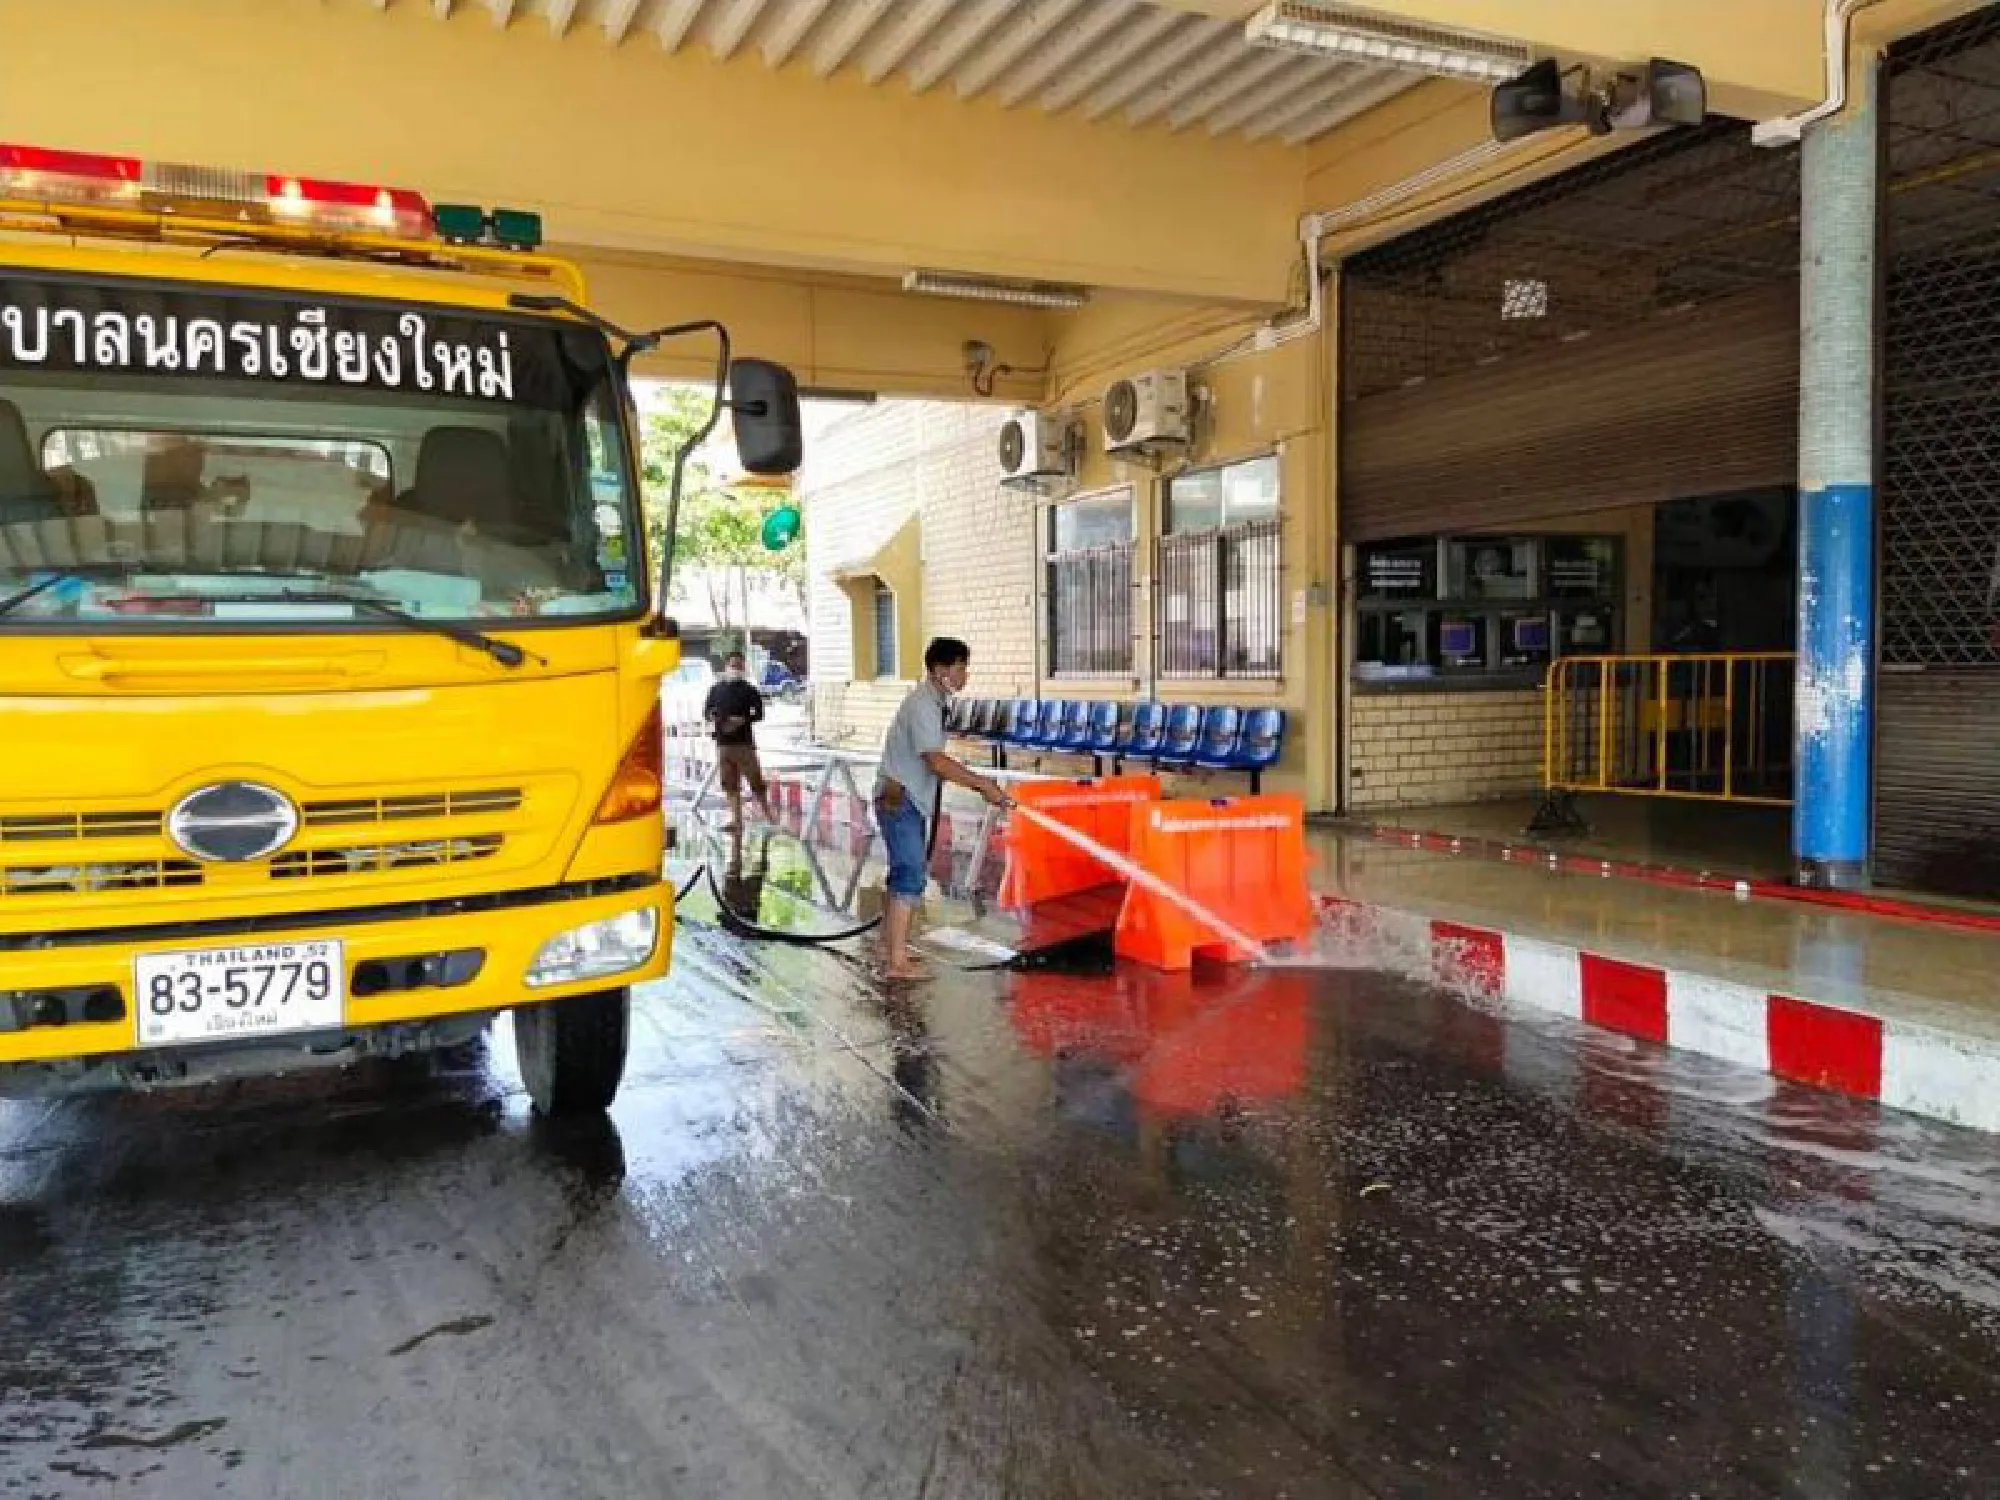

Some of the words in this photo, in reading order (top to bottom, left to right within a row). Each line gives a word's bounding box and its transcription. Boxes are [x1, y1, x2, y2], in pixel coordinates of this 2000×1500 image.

[2, 305, 514, 400] บาลนครเชียงใหม่
[184, 946, 296, 966] THAILAND
[150, 961, 330, 1016] 83-5779
